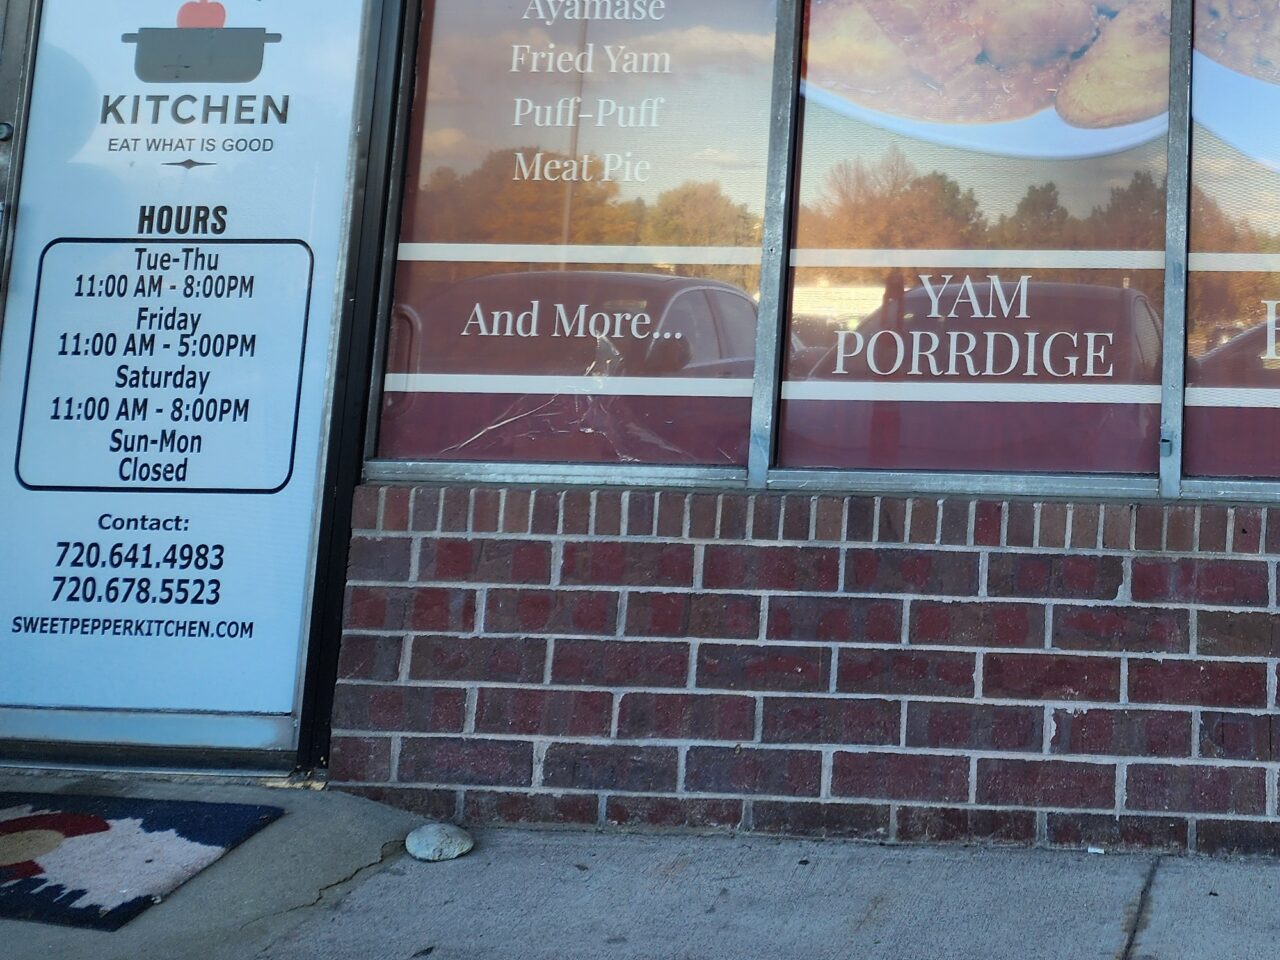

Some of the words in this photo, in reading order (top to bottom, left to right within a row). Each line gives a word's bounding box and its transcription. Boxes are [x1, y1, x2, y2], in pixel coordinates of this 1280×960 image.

[509, 43, 594, 73] Fried
[602, 45, 673, 74] Yam
[99, 94, 290, 125] KITCHEN
[511, 97, 665, 128] Puff-Puff
[107, 138, 140, 152] EAT
[145, 139, 195, 152] WHAT
[200, 139, 216, 152] IS
[221, 139, 274, 153] GOOD
[512, 152, 593, 182] Meat
[601, 152, 652, 182] Pie
[137, 205, 228, 235] HOURS
[134, 247, 219, 271] Tue-Thu
[74, 274, 128, 298] 11:00
[133, 274, 163, 298] AM
[182, 275, 255, 299] 8:00PM
[919, 274, 1031, 320] YAM
[136, 307, 202, 336] Friday
[461, 301, 540, 338] And
[551, 304, 683, 341] More...
[57, 332, 117, 357] 11:00
[123, 333, 155, 357] AM
[177, 334, 257, 358] 5:00PM
[832, 330, 1114, 378] PORRDIGE
[114, 364, 211, 395] Saturday
[49, 396, 110, 421] 11:00
[115, 397, 148, 422] AM
[170, 398, 250, 423] 8:00PM
[108, 428, 203, 454] Sun-Mon
[118, 457, 188, 482] Closed
[98, 514, 189, 531] Contact:
[54, 541, 226, 570] 720.641.4983
[51, 576, 221, 605] 720.678.5523
[11, 616, 254, 639] SWEETPEPPERKITCHEN.COM
